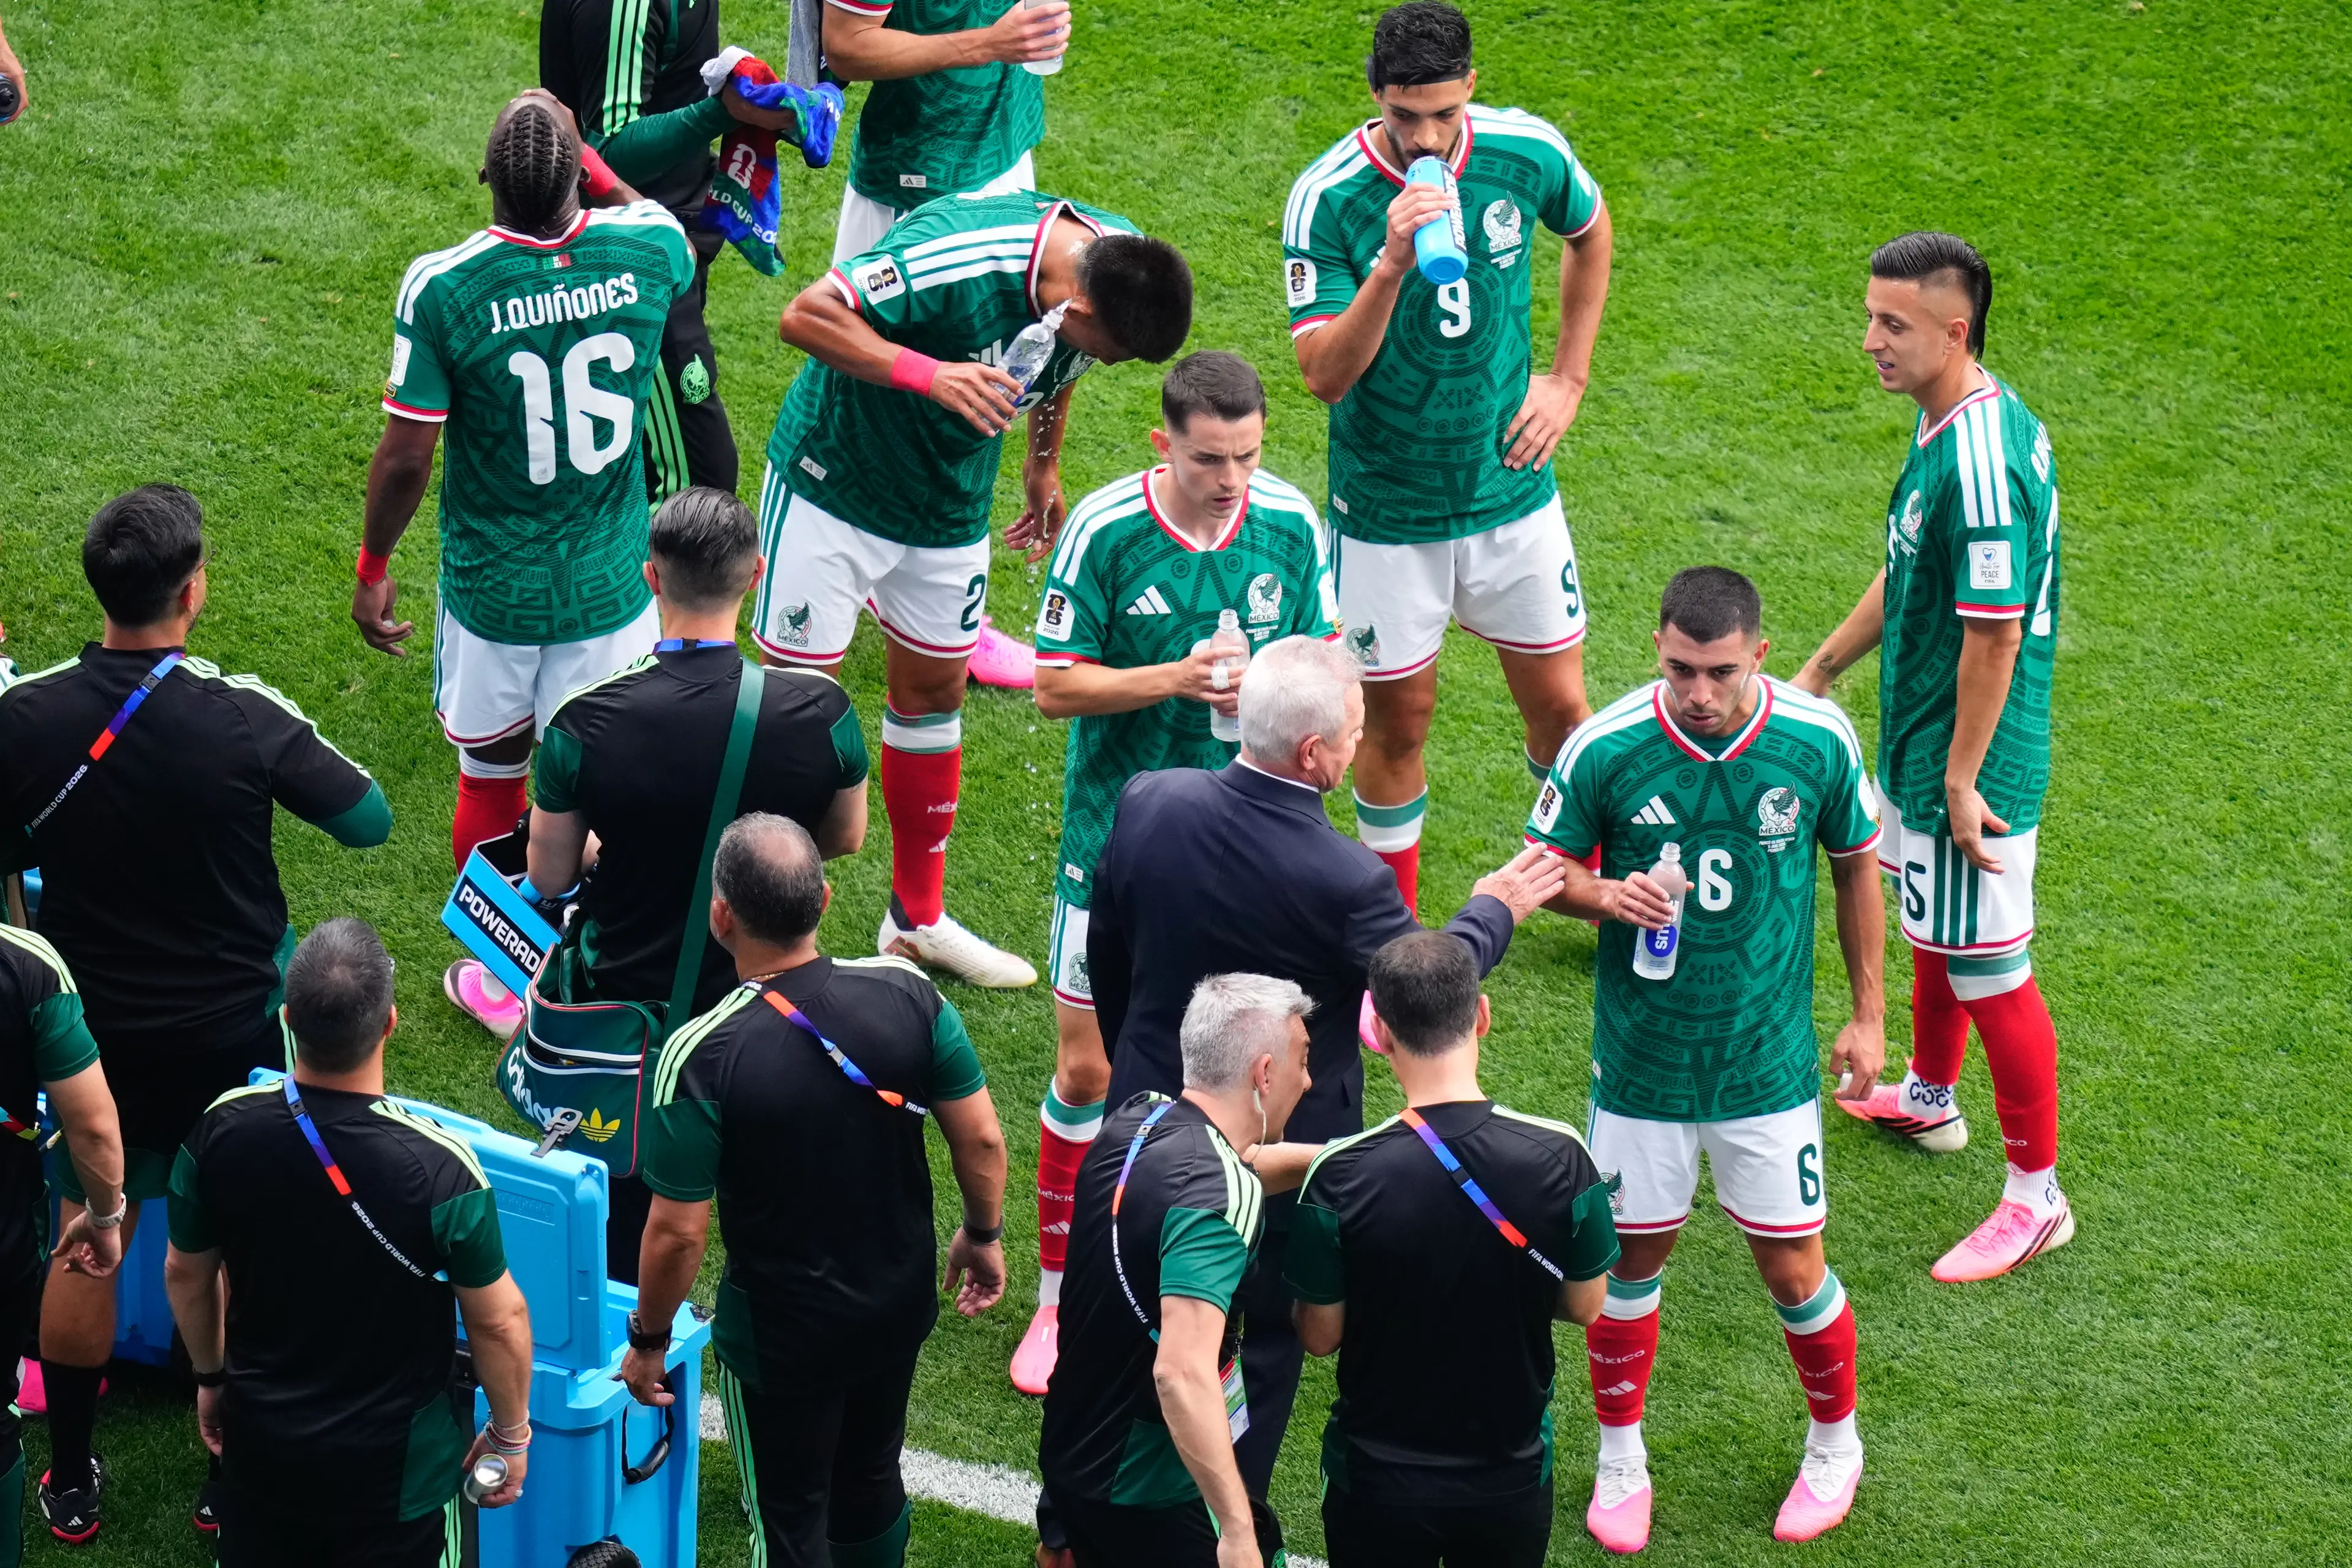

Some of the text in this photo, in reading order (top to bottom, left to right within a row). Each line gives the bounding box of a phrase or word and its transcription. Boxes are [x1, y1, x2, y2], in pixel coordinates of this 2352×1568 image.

[733, 200, 753, 224] CUP
[752, 223, 778, 244] 20
[1444, 170, 1468, 251] POWERDE
[1438, 277, 1471, 337] 9
[508, 332, 635, 485] 16
[960, 573, 986, 632] 2
[1561, 559, 1579, 618] 9
[31, 764, 88, 829] FIFA WORLD CUP 2026
[1698, 848, 1733, 911] 6
[1905, 860, 1926, 921] 5
[905, 1101, 918, 1112] FIFA
[1797, 1143, 1820, 1206] 6
[352, 1200, 426, 1278] FIFA WORLD CUP 2026
[1114, 1256, 1123, 1275] CUP
[1528, 1248, 1543, 1262] FIFA
[1541, 1257, 1559, 1275] WORLD
[1119, 1274, 1137, 1306] WORLD
[1134, 1305, 1148, 1324] FIFA
